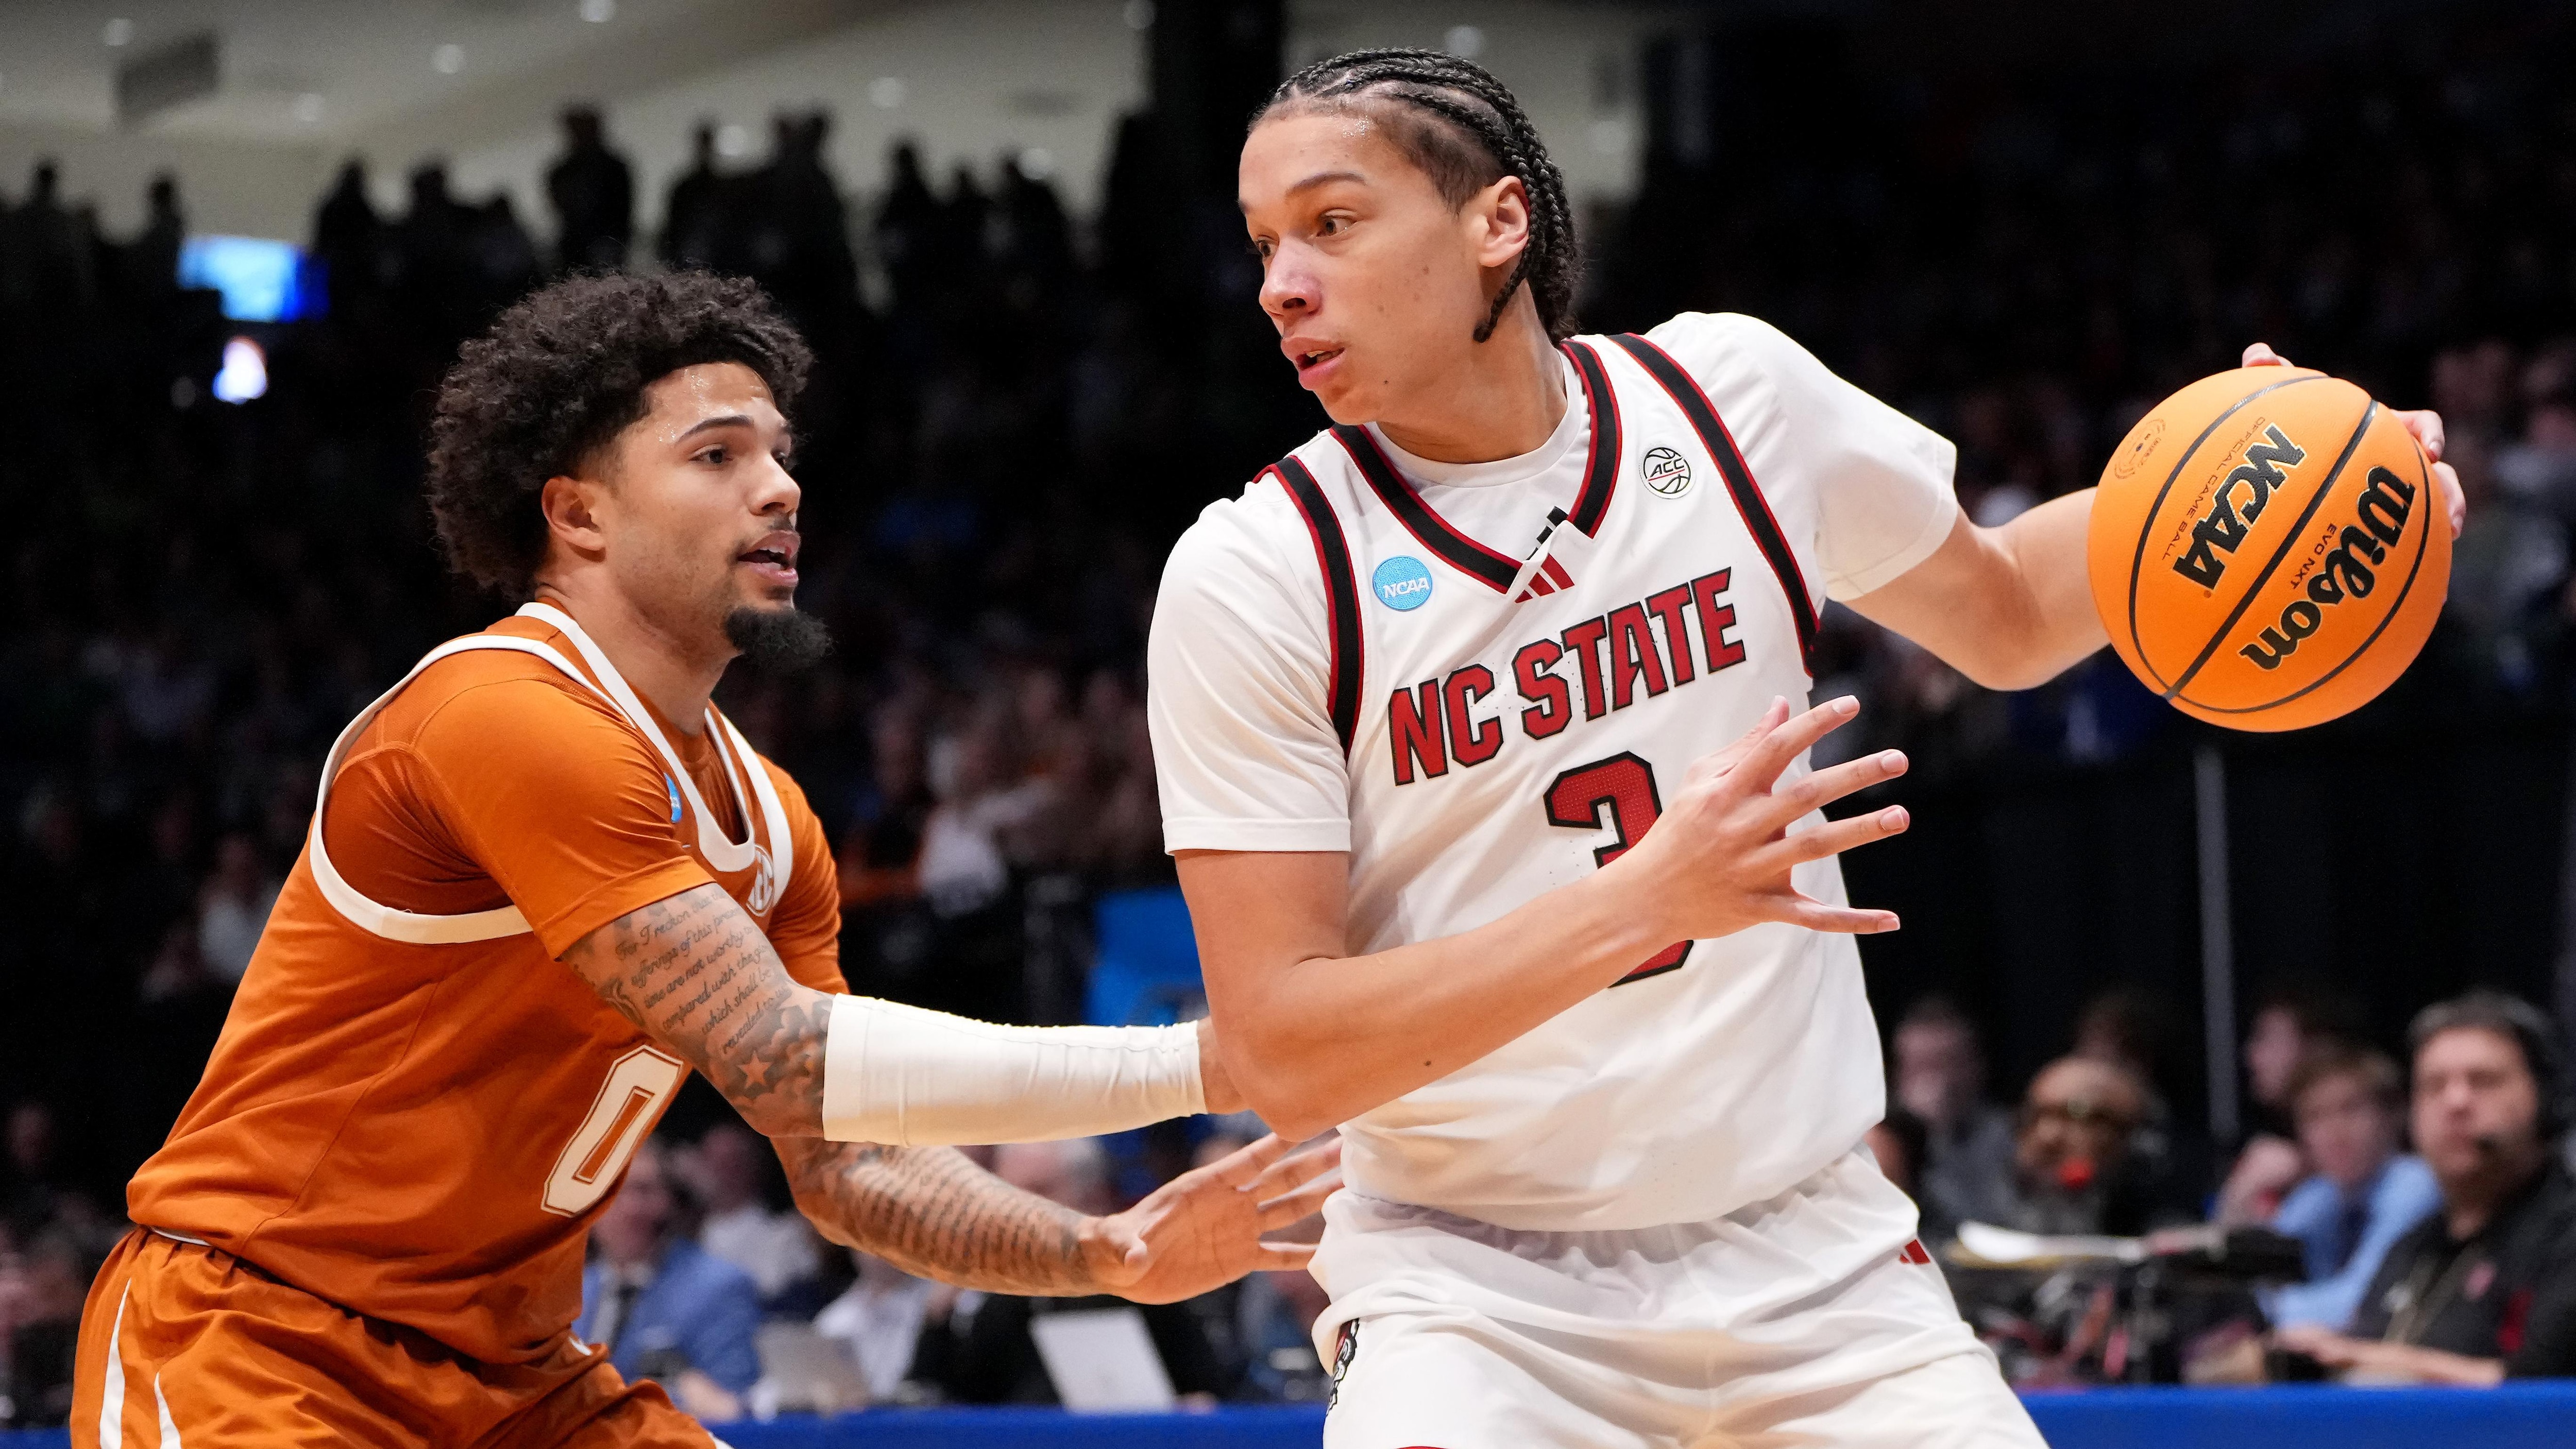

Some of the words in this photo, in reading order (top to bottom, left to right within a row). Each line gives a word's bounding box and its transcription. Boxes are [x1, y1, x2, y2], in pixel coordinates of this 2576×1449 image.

[2216, 416, 2266, 473] OFFICIAL
[1650, 457, 1685, 478] ACC
[2173, 422, 2308, 591] NCAA
[2186, 473, 2218, 518] GAME
[2162, 521, 2188, 561] BALL
[2312, 523, 2337, 555] EVO
[1382, 576, 1430, 599] NCAA
[2239, 465, 2416, 671] Wilson
[2290, 558, 2316, 590] NXT
[1387, 663, 1504, 787] NC
[1511, 566, 1747, 741] STATE
[541, 1045, 684, 1218] 0
